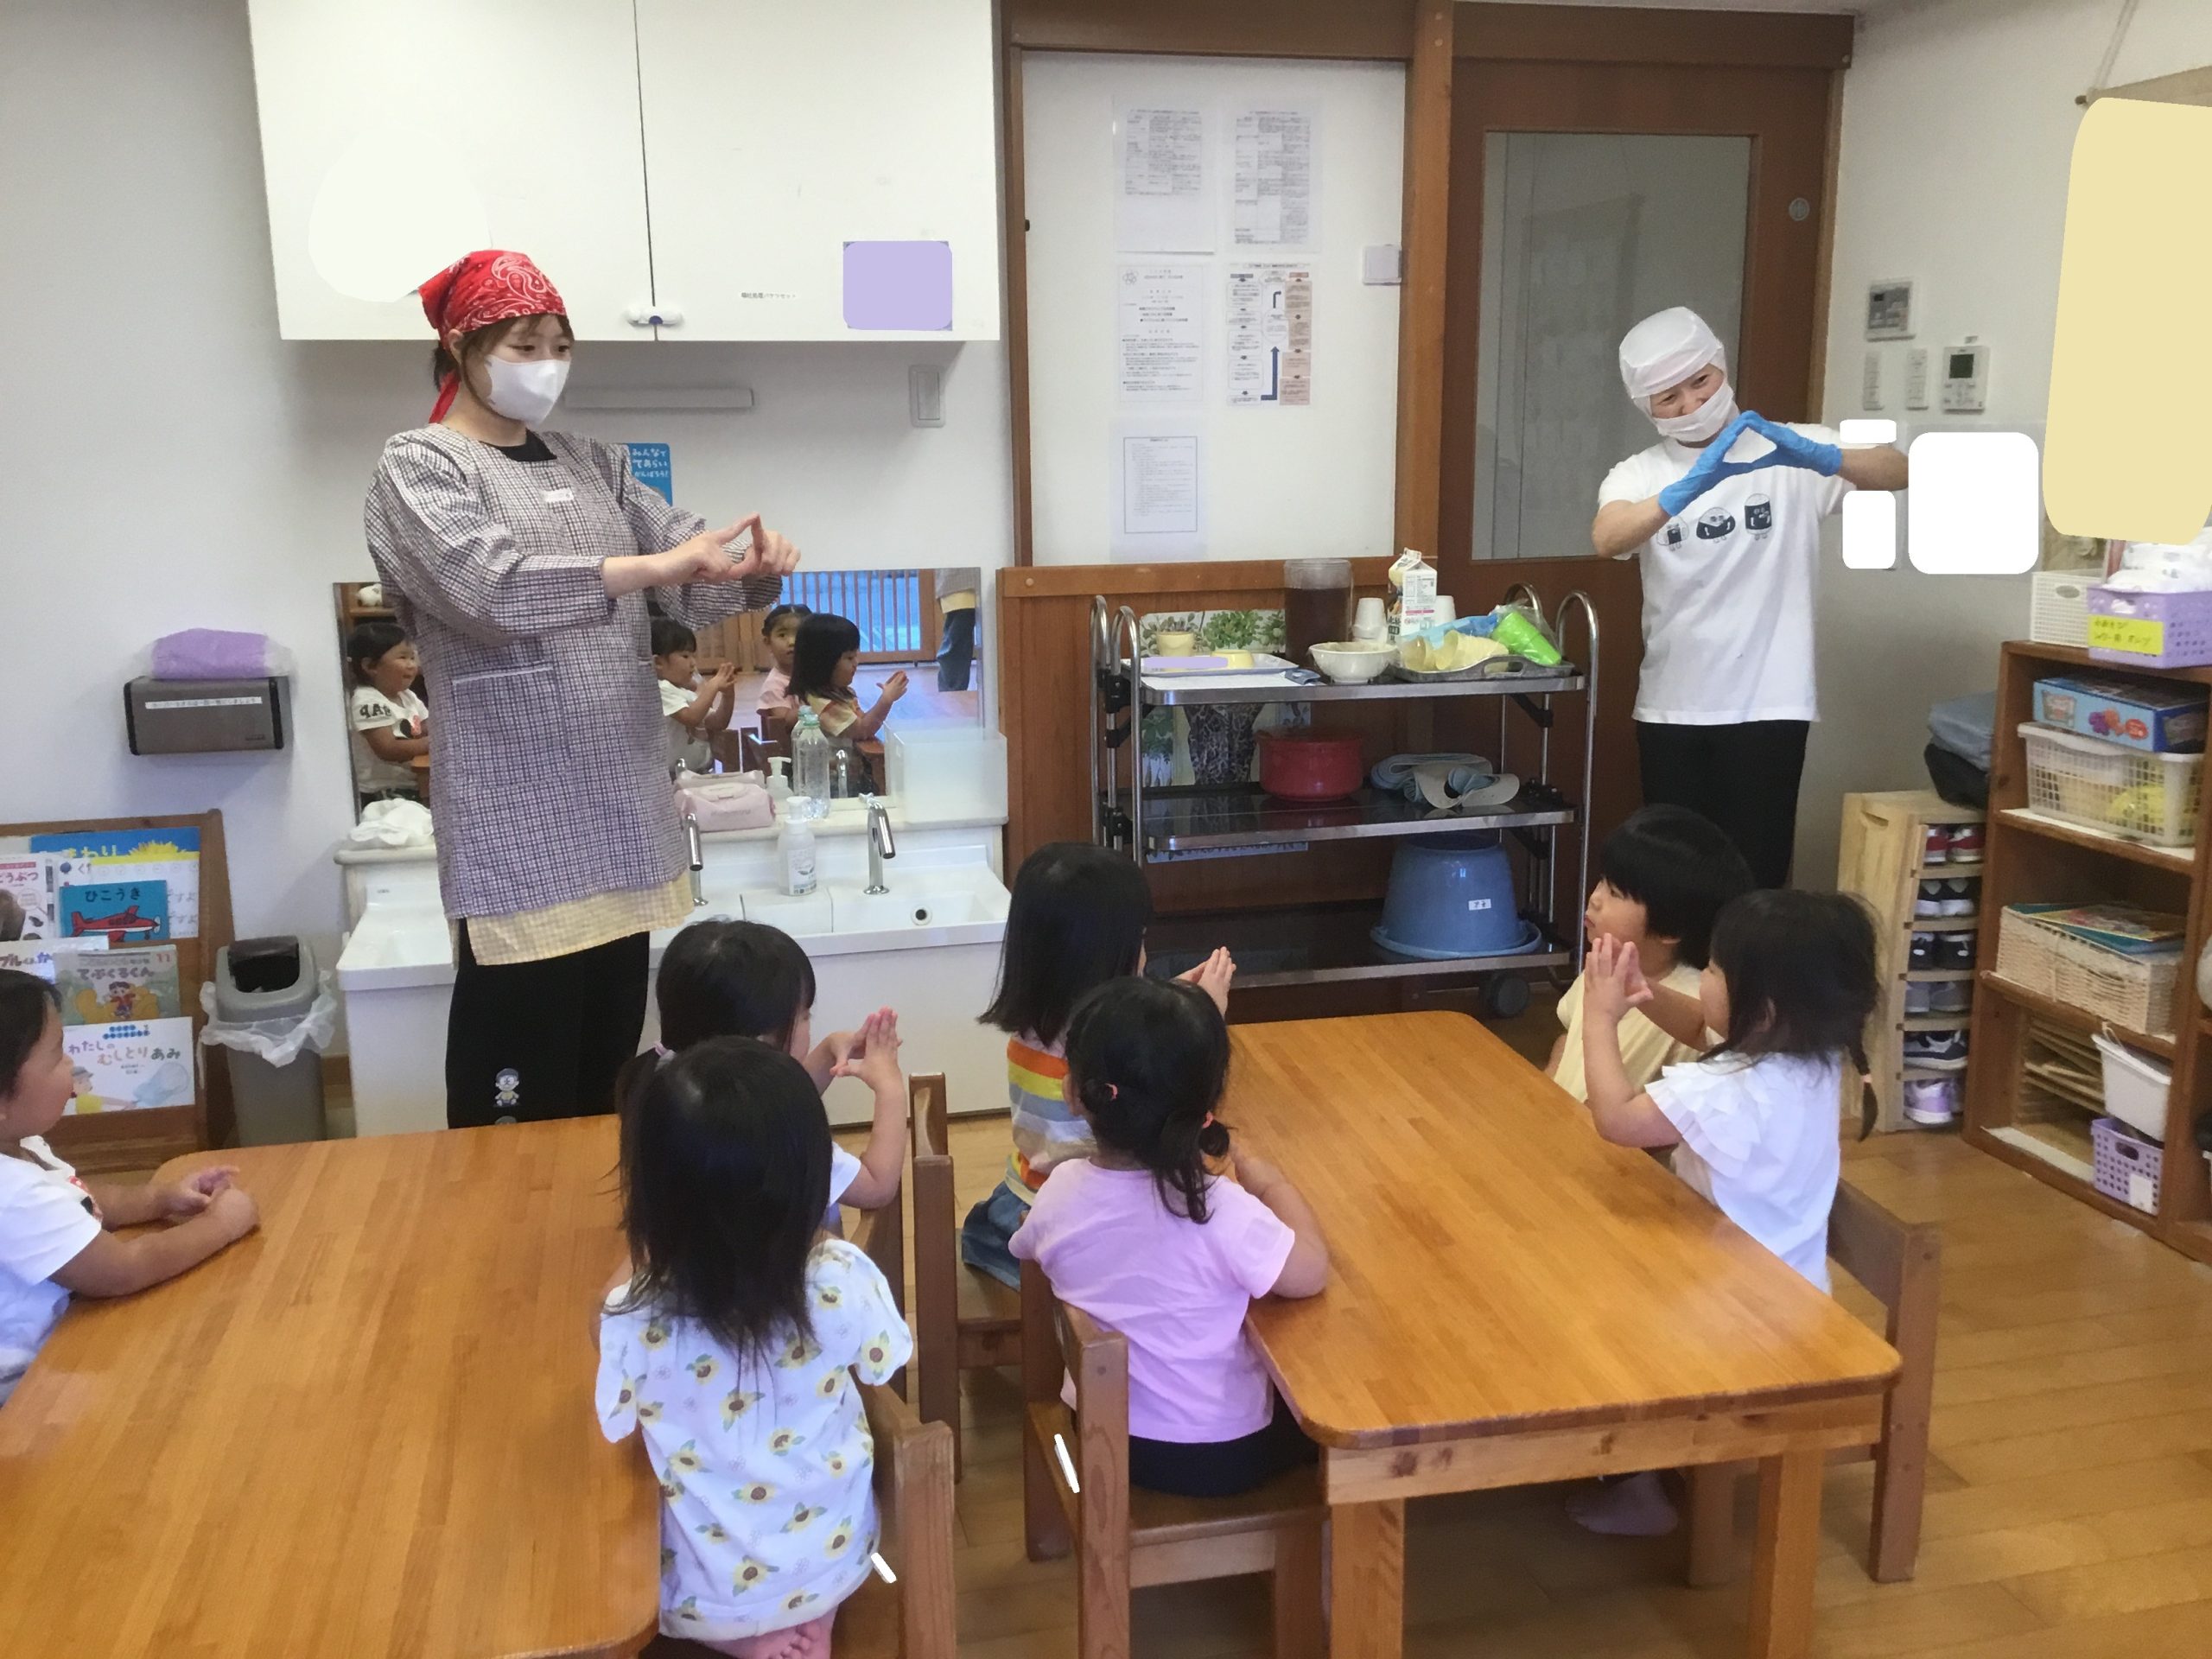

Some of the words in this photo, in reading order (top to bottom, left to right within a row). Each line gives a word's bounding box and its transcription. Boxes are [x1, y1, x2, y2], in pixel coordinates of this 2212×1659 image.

[632, 459, 668, 468] てあらい
[85, 887, 141, 902] ひこうき
